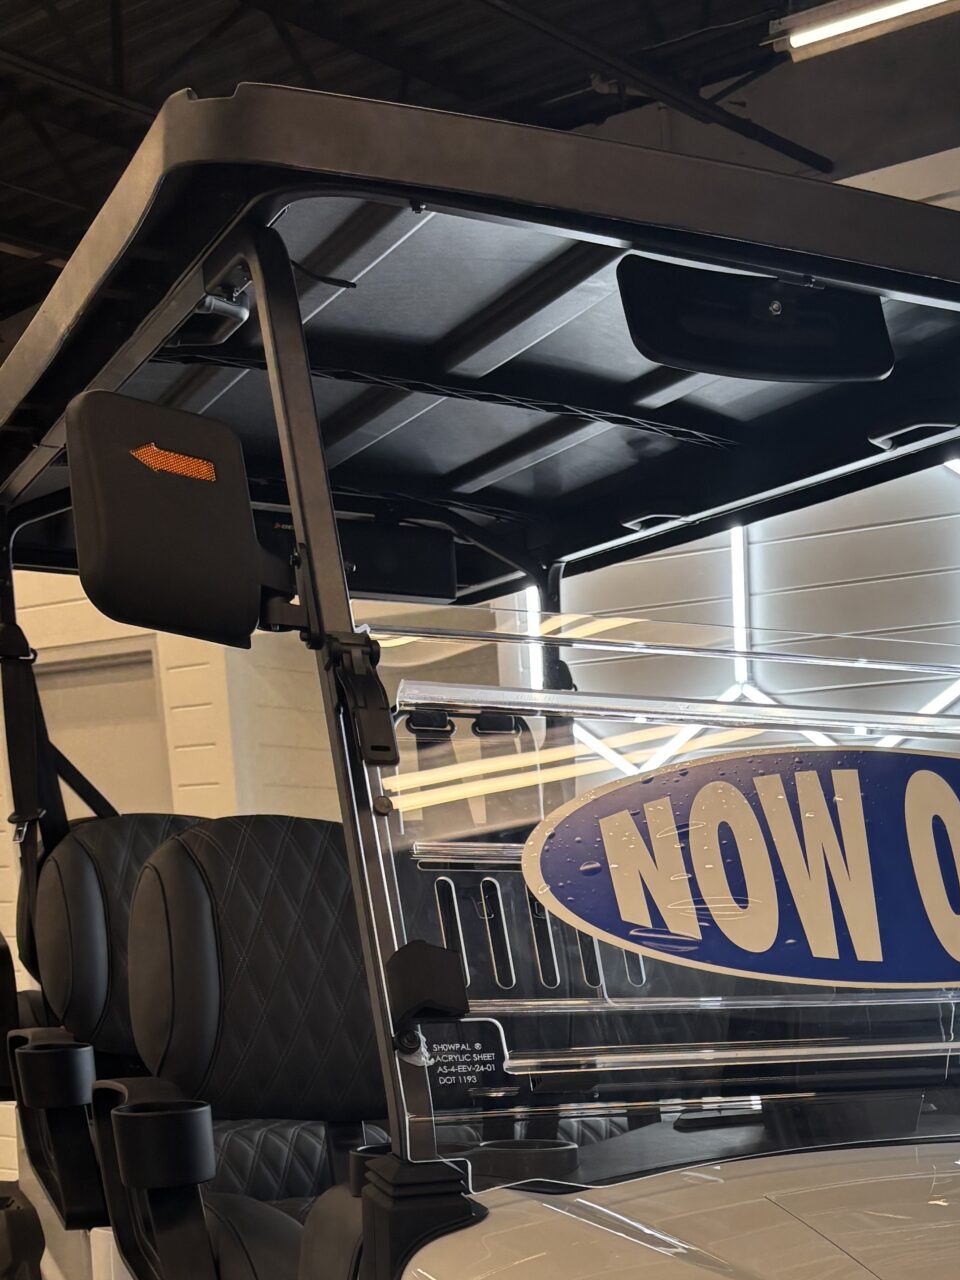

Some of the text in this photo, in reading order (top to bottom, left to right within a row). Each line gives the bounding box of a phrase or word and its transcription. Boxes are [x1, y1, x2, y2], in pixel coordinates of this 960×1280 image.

[599, 768, 883, 962] NOW
[432, 1043, 471, 1052] SHOWPAL
[435, 1053, 496, 1063] ACRYLIC SHEET
[437, 1064, 496, 1073] AS-4-EEV-24-01
[439, 1075, 477, 1085] DOT 1193
